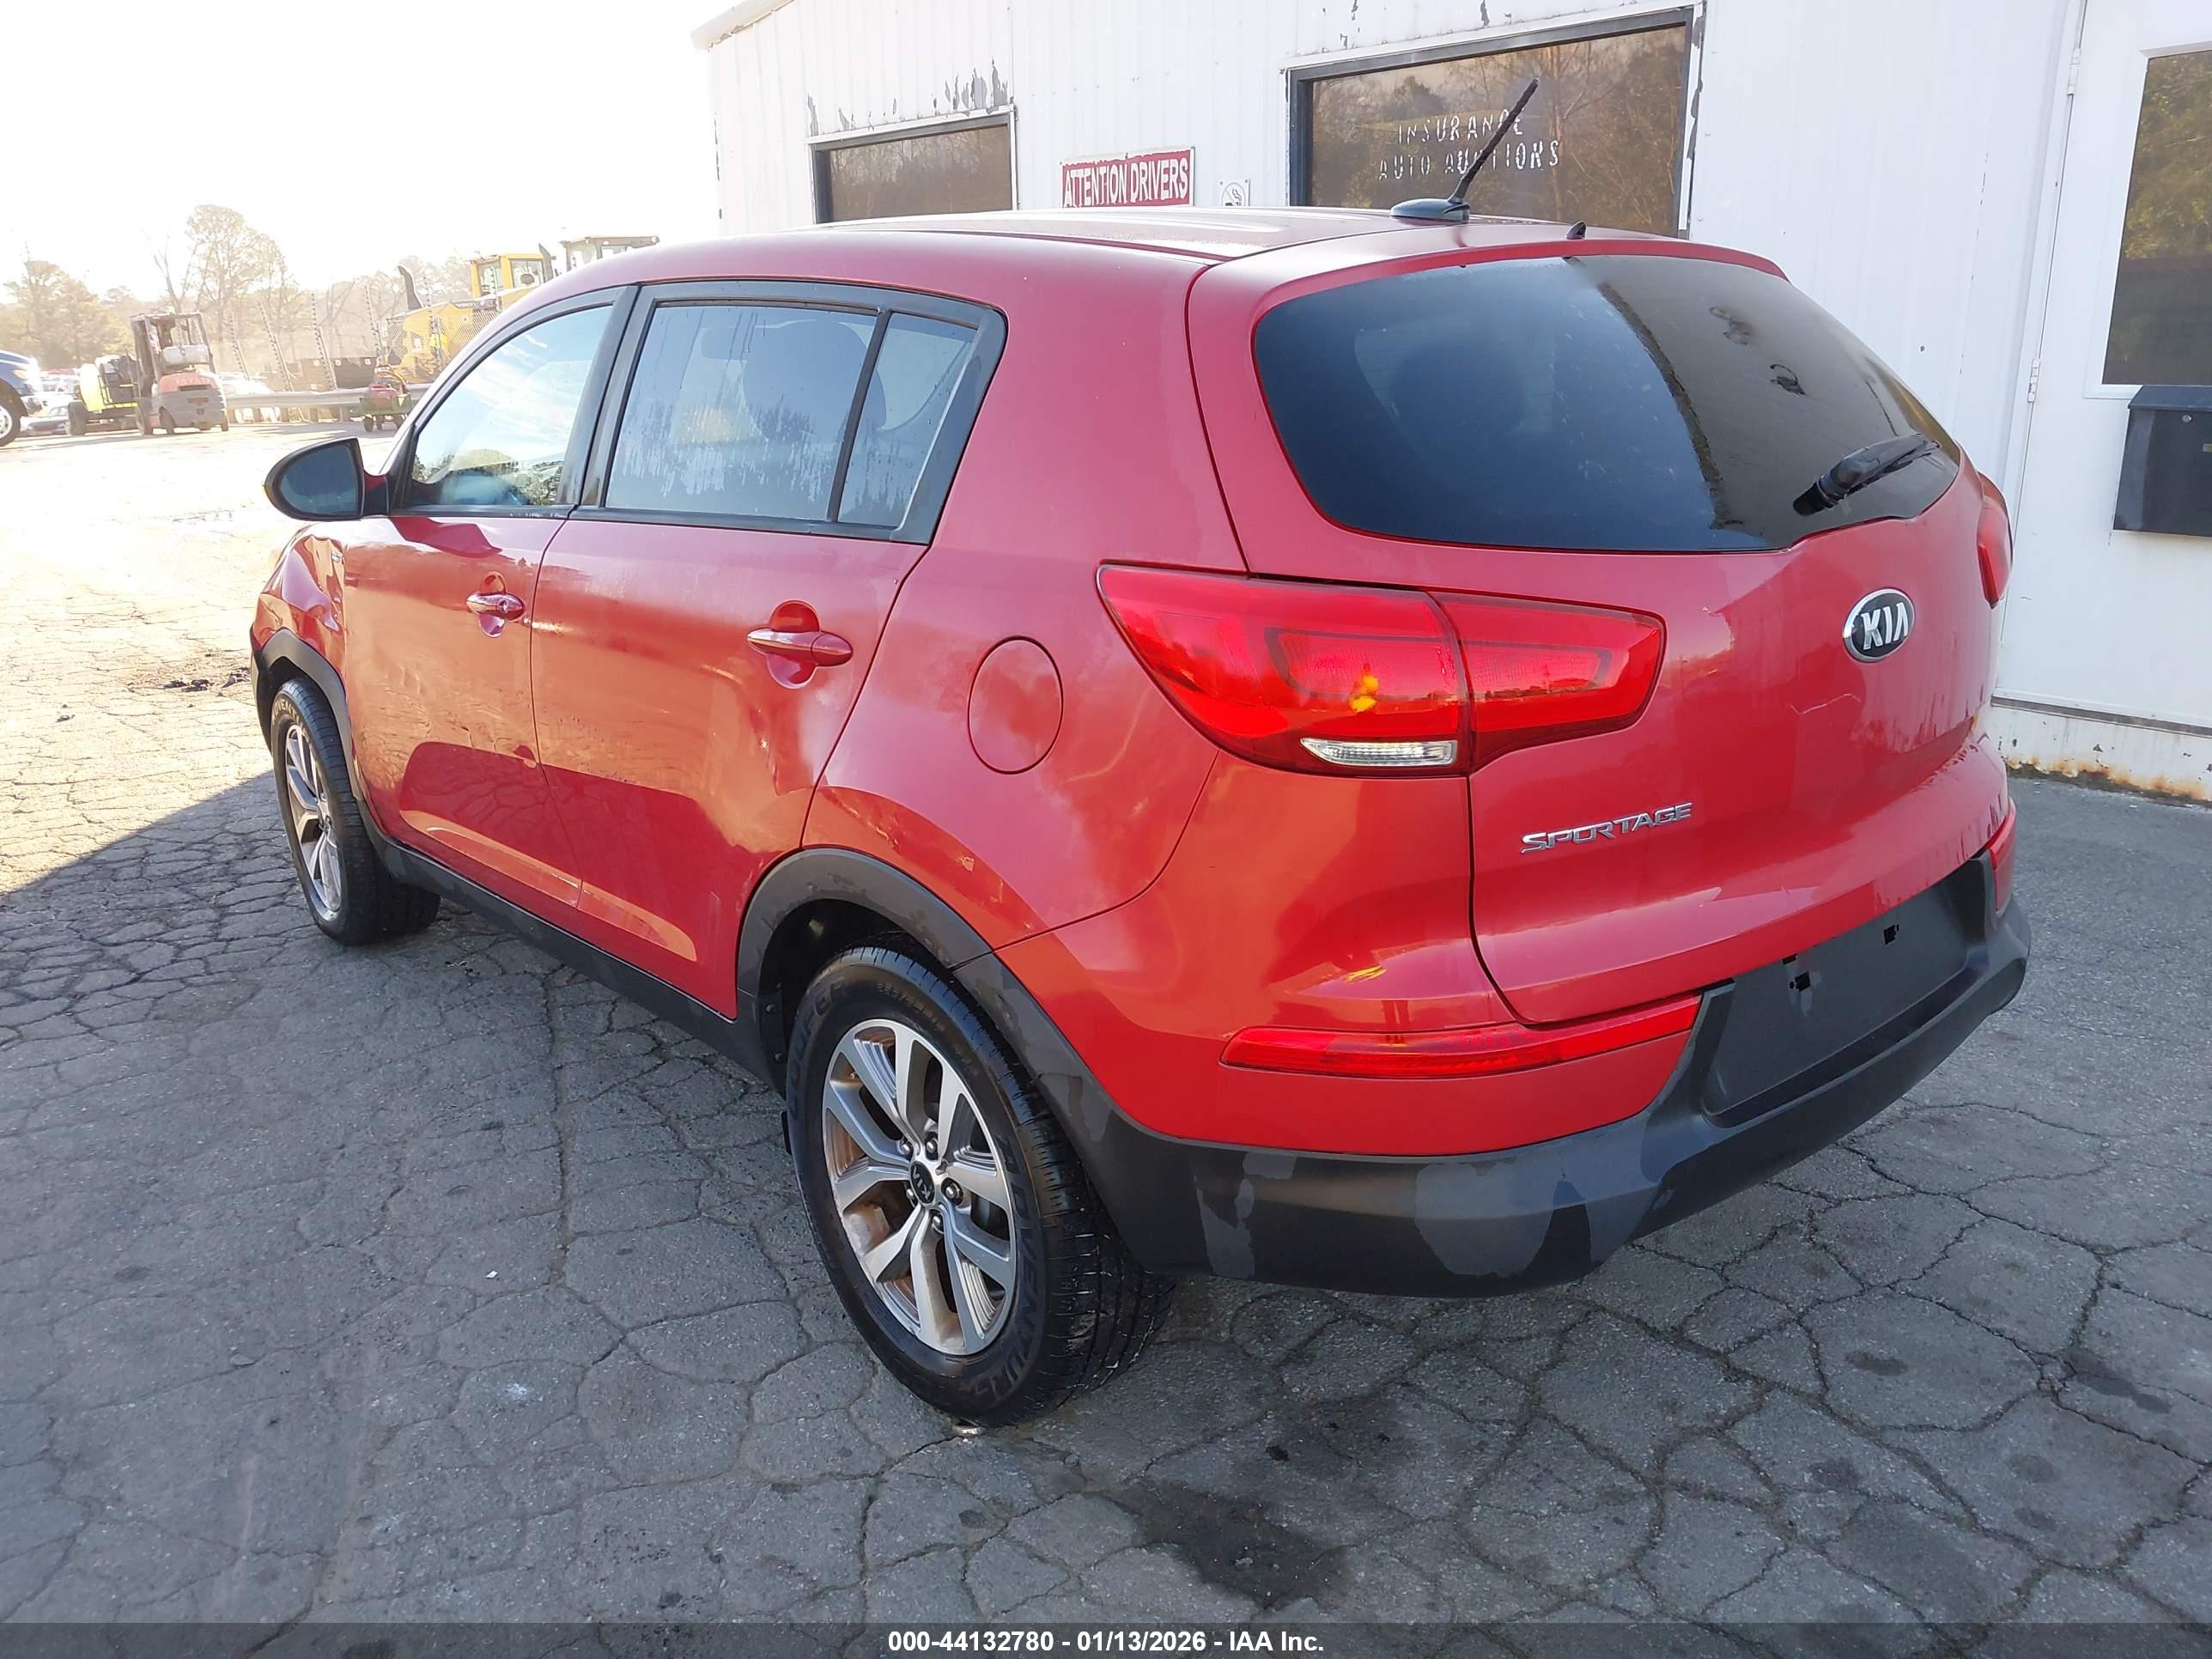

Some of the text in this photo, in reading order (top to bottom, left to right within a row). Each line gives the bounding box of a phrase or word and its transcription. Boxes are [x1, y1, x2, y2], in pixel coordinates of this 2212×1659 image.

[1399, 109, 1523, 145] INSURANCE
[1063, 157, 1188, 208] ATTENTION DRIVERS
[1379, 154, 1431, 181] AUTO
[1860, 601, 1910, 651] KIA
[1521, 802, 1692, 854] SPORTAGE
[912, 1165, 931, 1200] KIA
